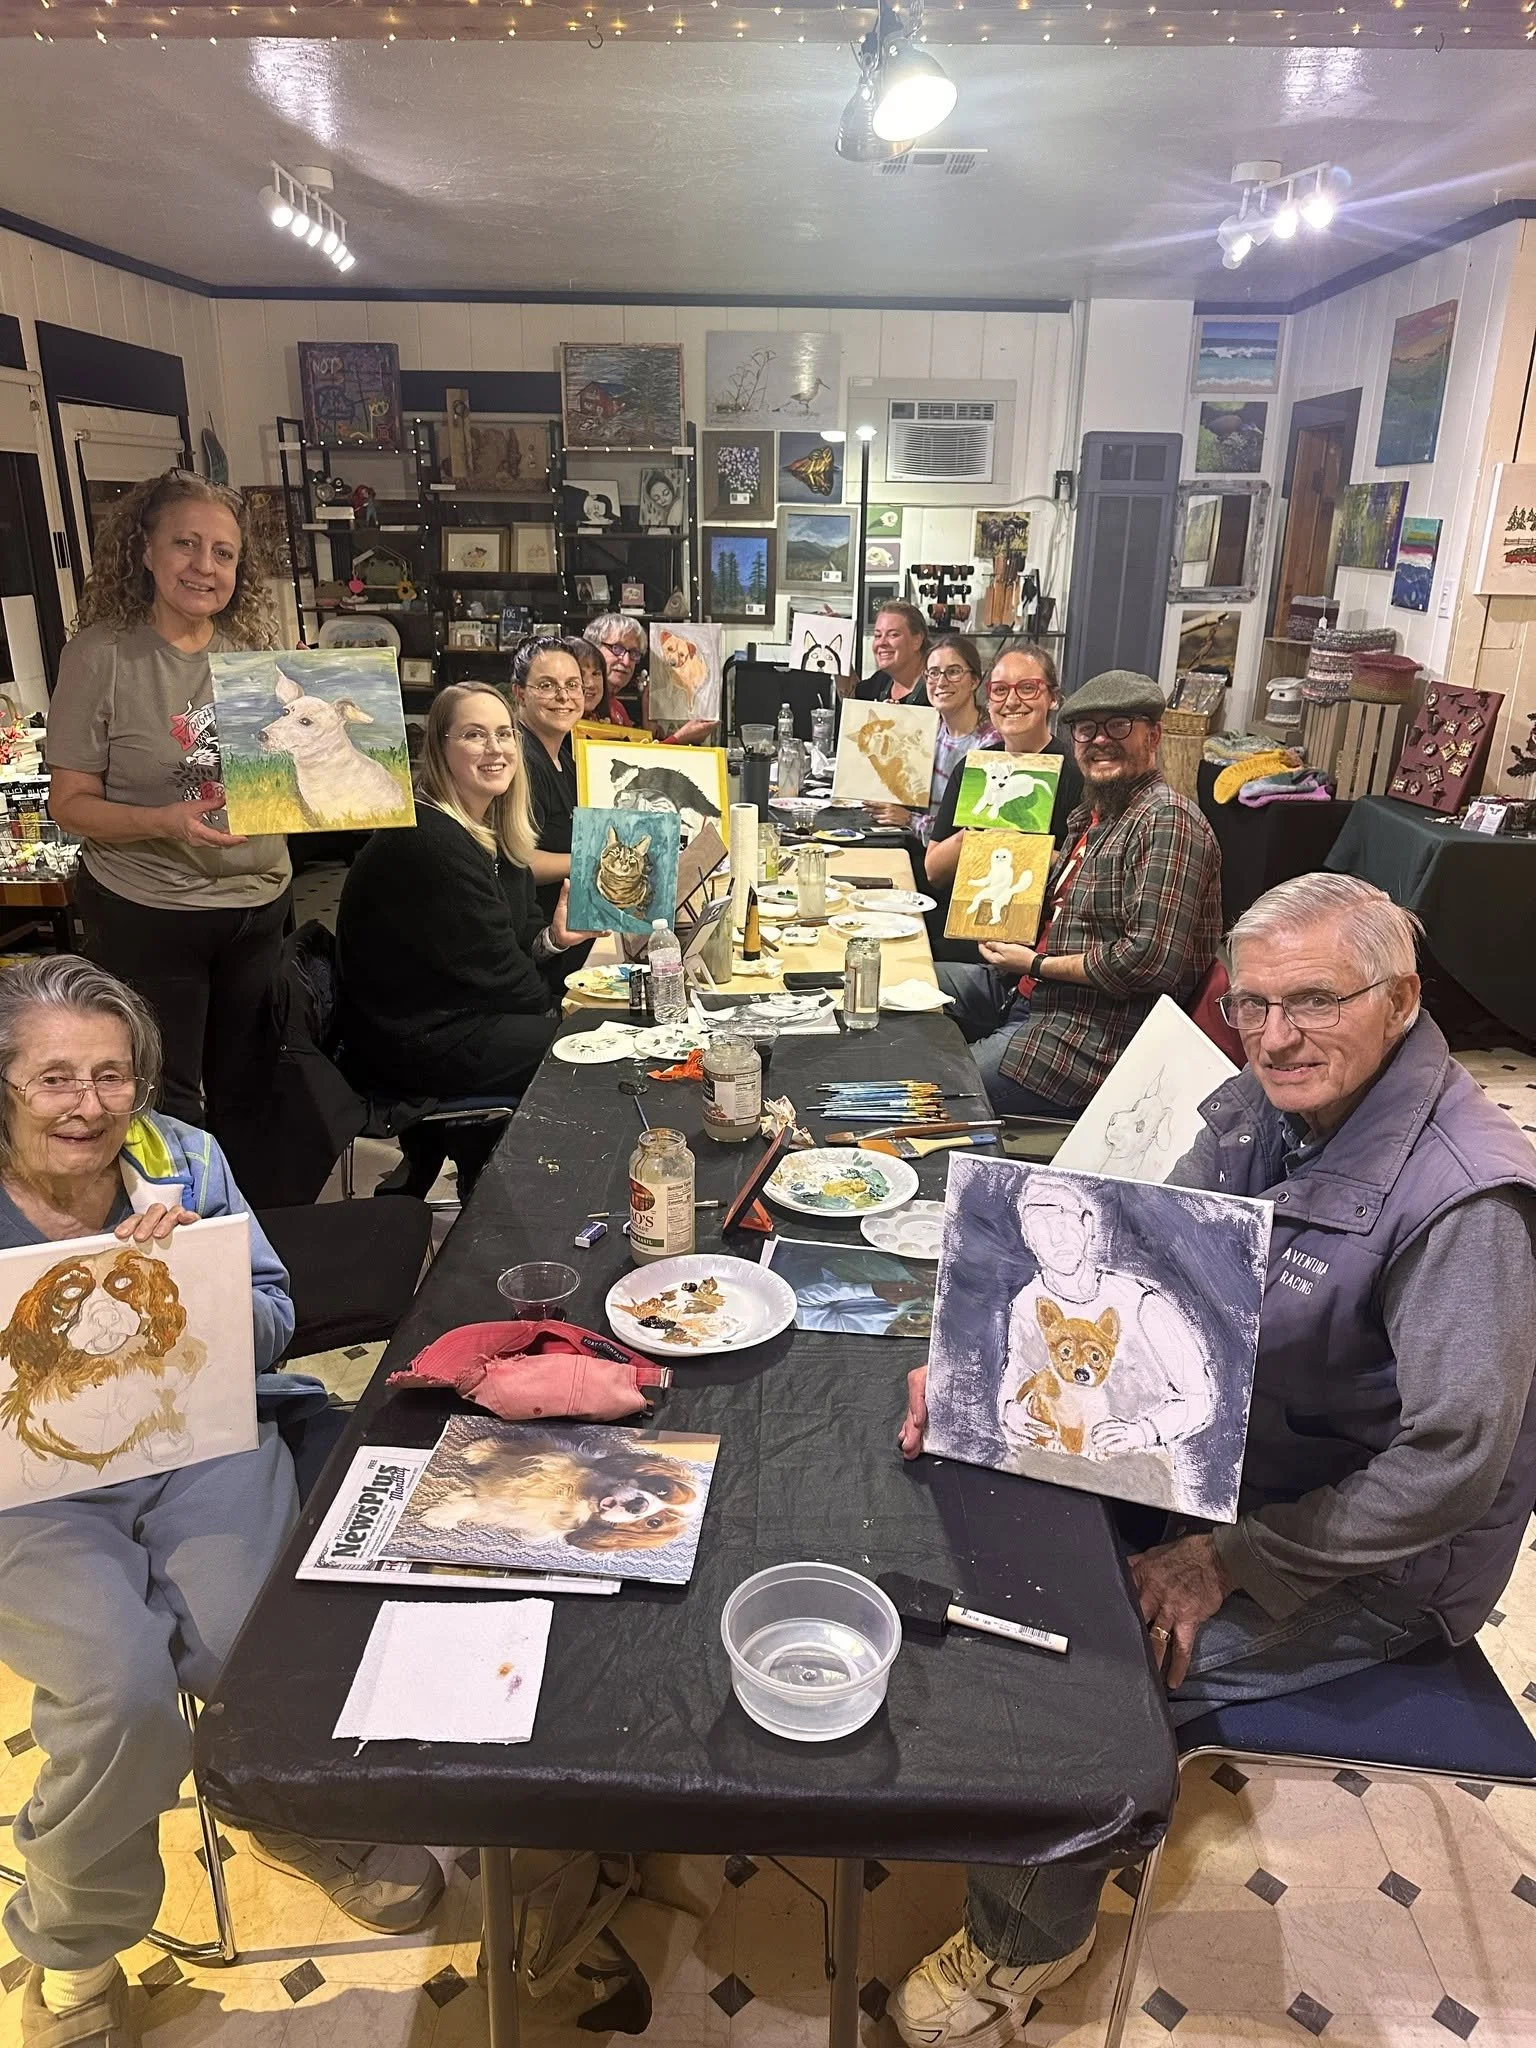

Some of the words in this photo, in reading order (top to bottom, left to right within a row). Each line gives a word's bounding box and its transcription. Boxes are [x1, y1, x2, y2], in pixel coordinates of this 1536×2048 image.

[190, 708, 214, 733] RIGH
[1281, 1247, 1330, 1275] AVENTURA
[1279, 1270, 1314, 1295] RACING
[367, 1459, 378, 1470] FREE
[388, 1466, 411, 1501] Monthly
[330, 1464, 399, 1558] NewsPlus
